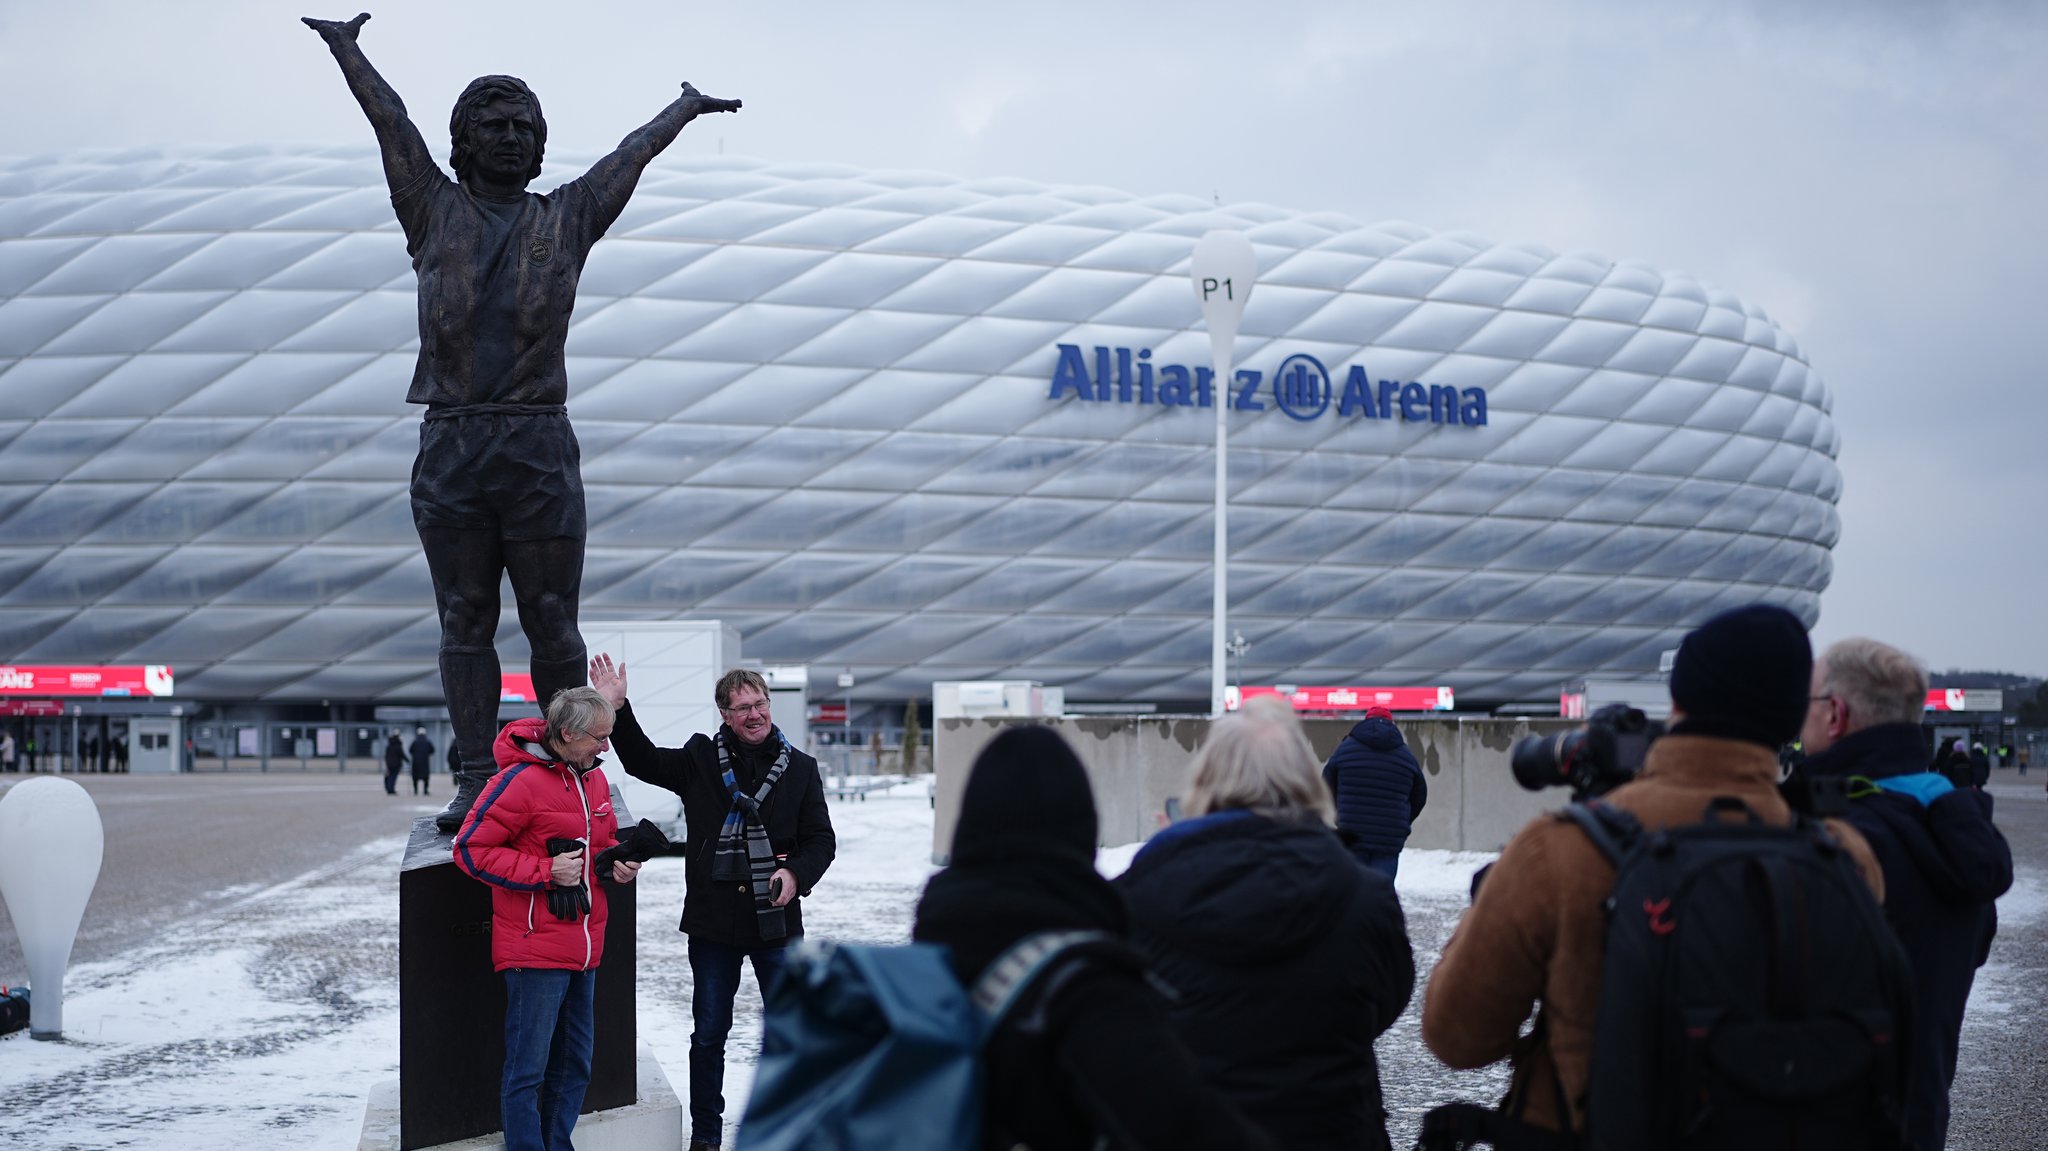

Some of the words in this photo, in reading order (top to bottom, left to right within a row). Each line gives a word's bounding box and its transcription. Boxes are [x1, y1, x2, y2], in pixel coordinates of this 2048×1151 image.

[1202, 276, 1233, 302] P1
[1049, 344, 1265, 411] Allianz
[1339, 365, 1488, 426] Arena
